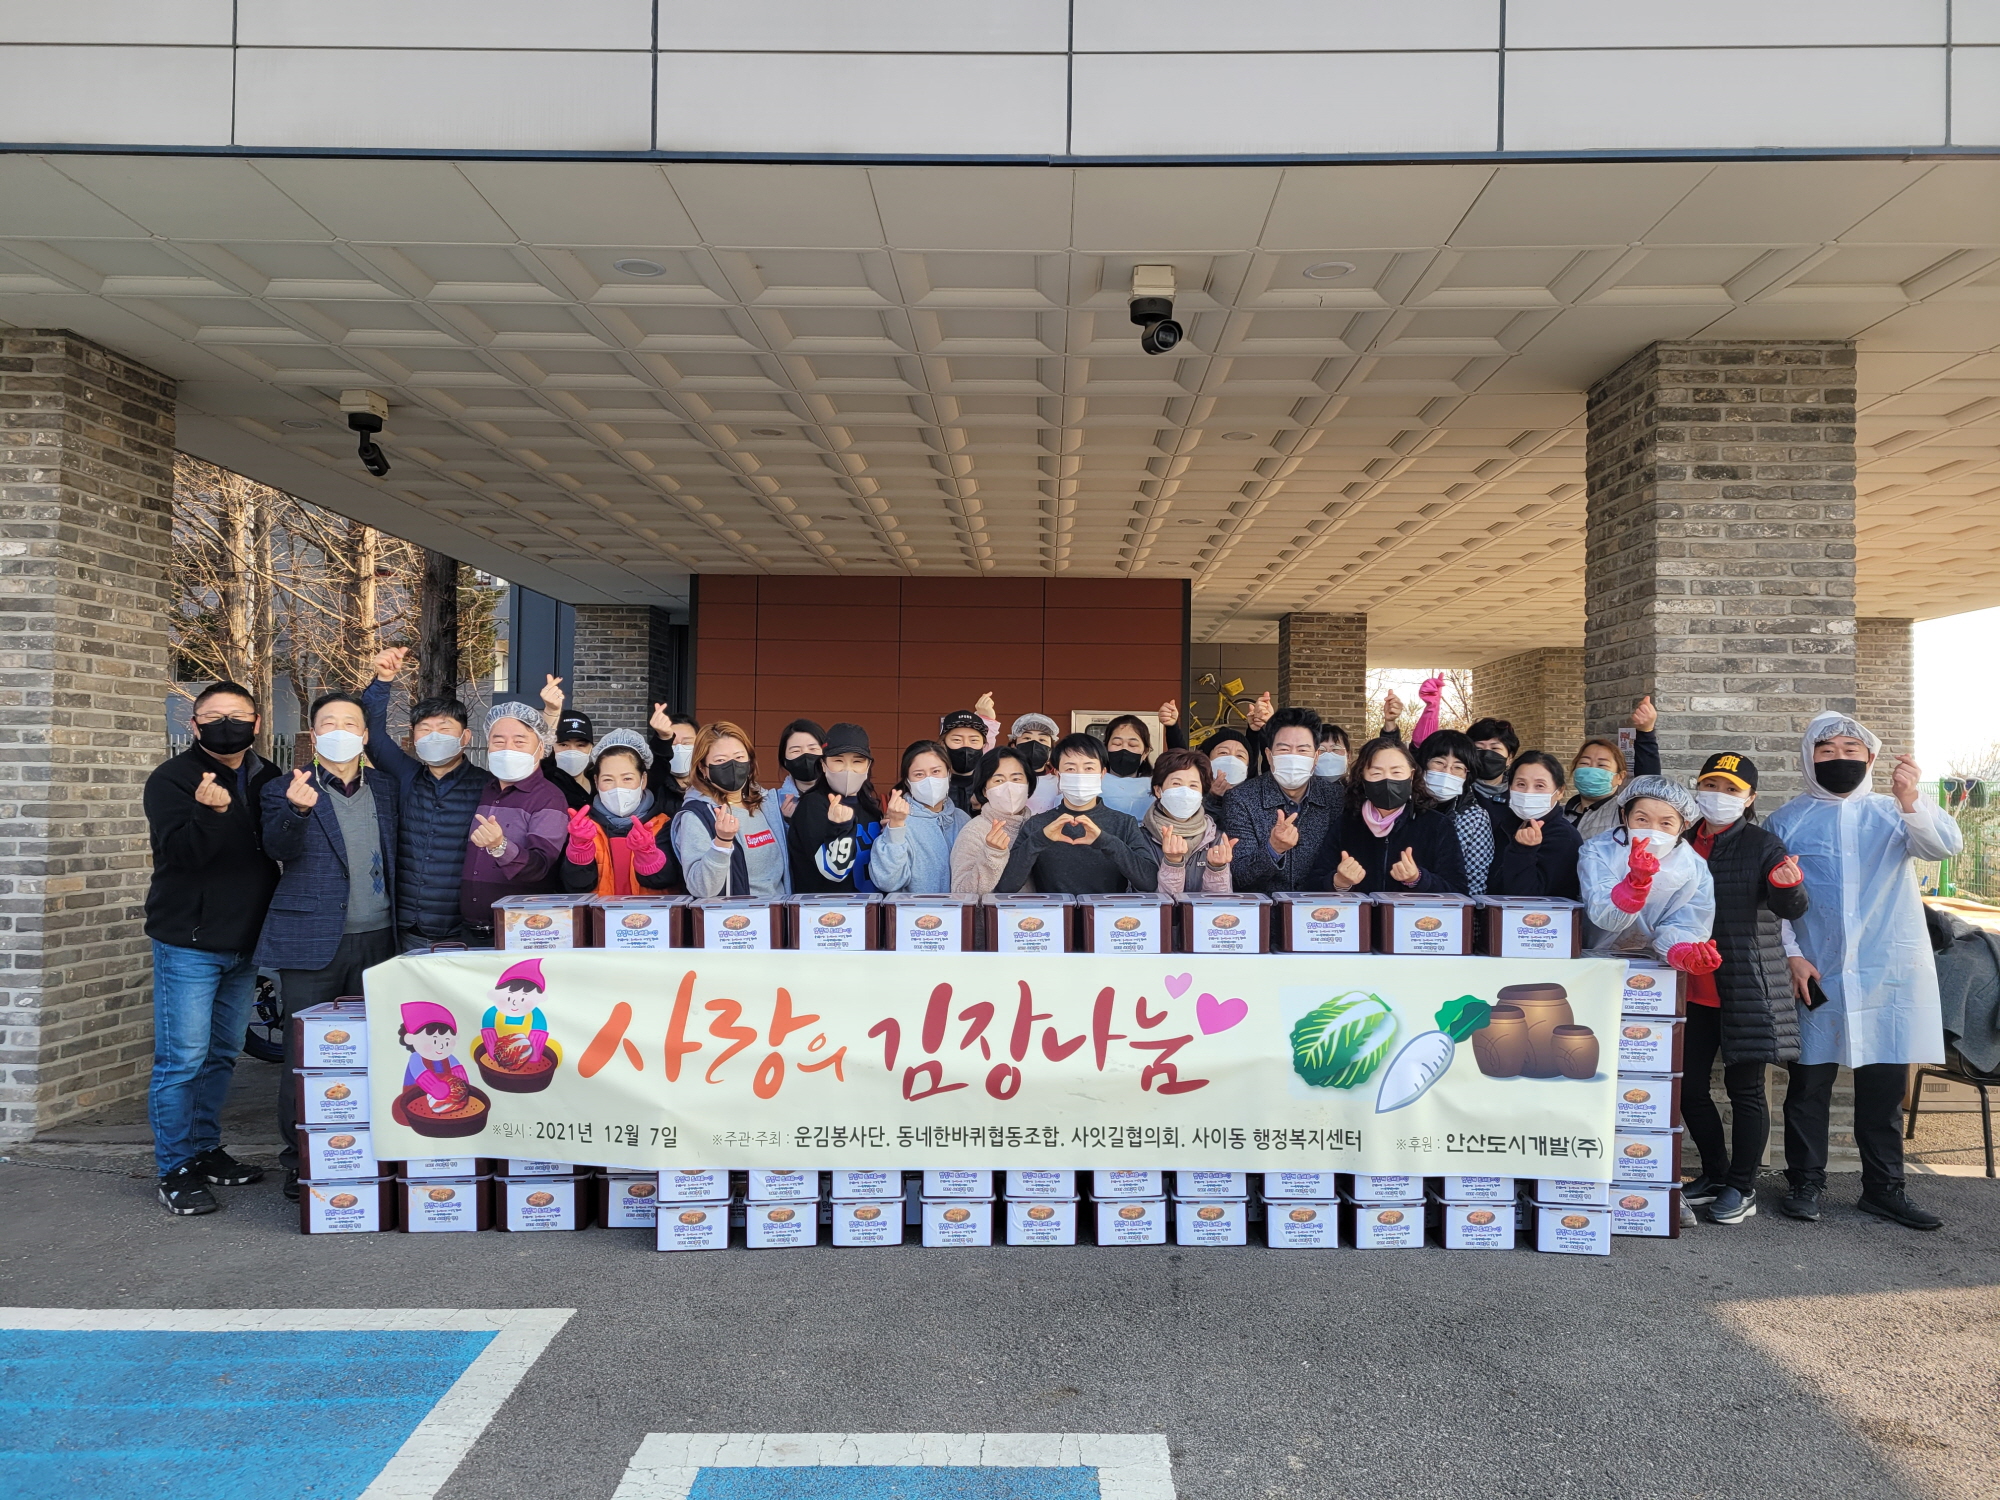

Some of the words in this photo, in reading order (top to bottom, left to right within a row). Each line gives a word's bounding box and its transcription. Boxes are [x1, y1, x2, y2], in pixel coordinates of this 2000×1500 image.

[746, 832, 773, 846] Supreme
[577, 970, 848, 1100] 사랑의
[867, 980, 1210, 1102] 김장나눔
[536, 1121, 593, 1144] 2021년
[604, 1124, 639, 1147] 12월
[650, 1125, 678, 1148] 7일
[794, 1125, 890, 1148] 운김봉사단.
[896, 1125, 1065, 1148] 동네한바퀴협동조합.
[1071, 1126, 1185, 1149] 사잇길협의회.
[1192, 1126, 1247, 1150] 사이동
[1252, 1127, 1362, 1152] 행정복지센터
[1446, 1133, 1604, 1159] 안산도시개발(주)
